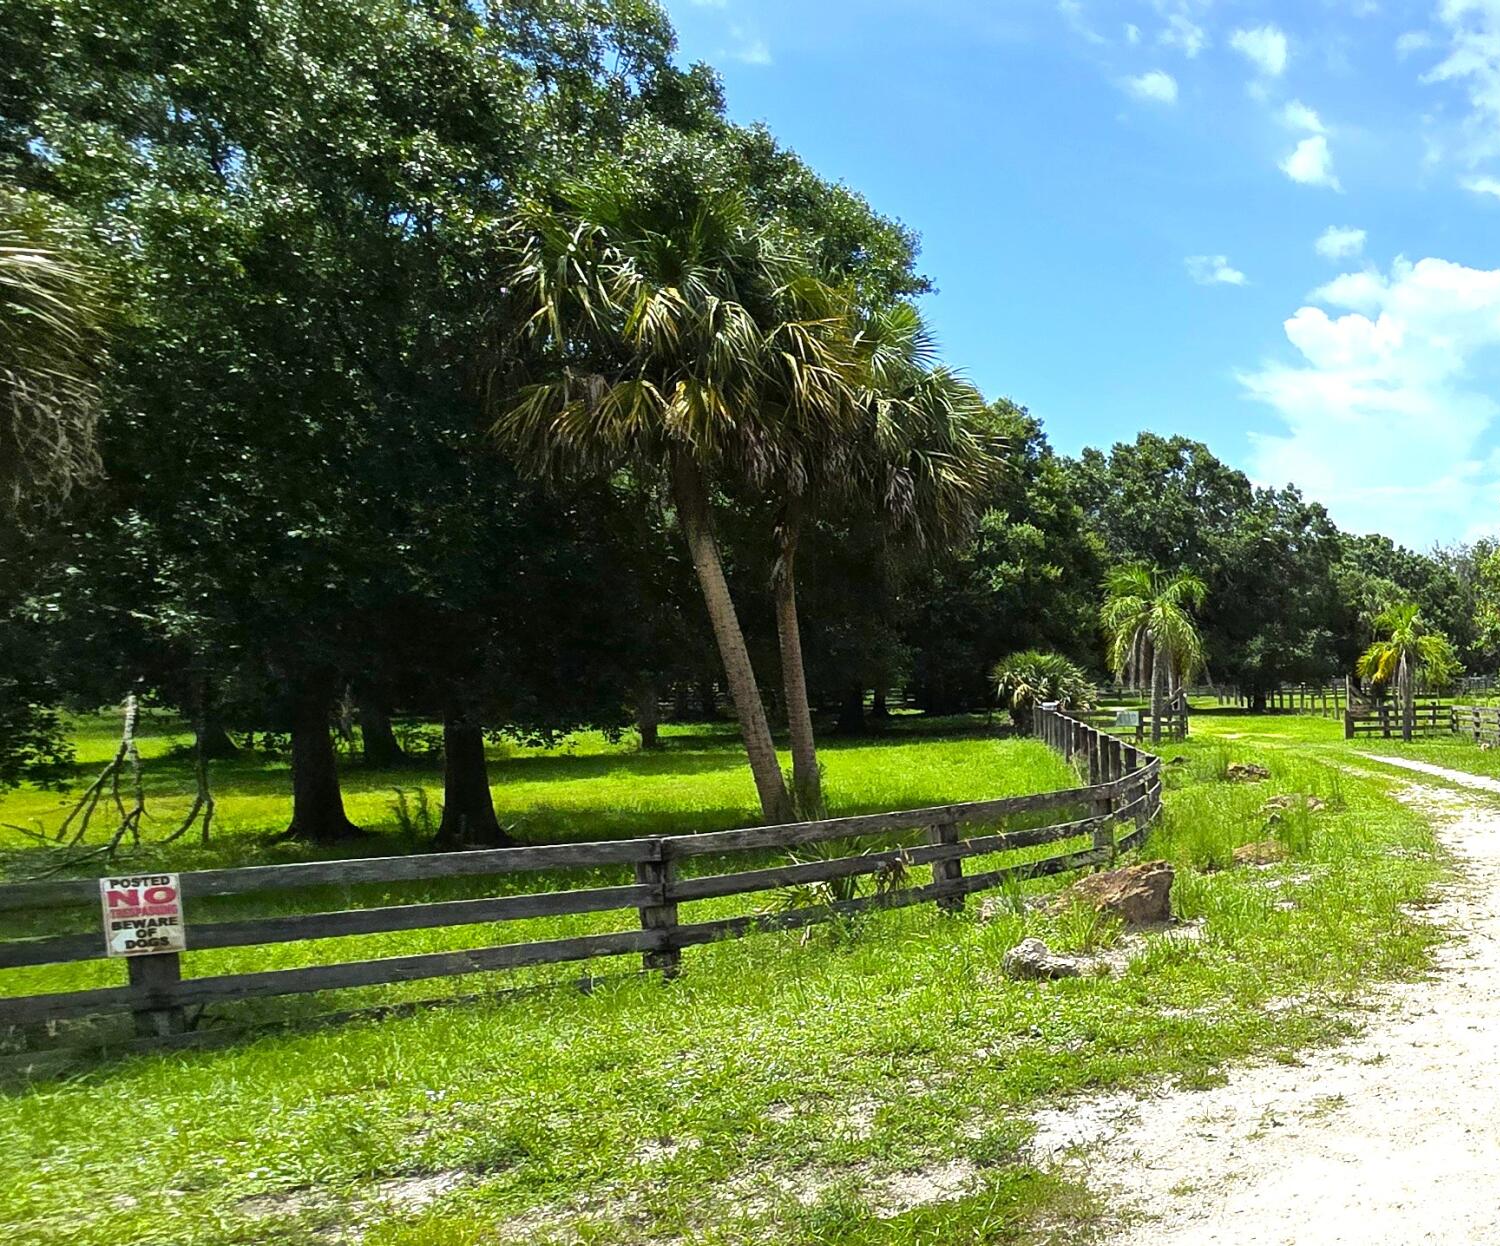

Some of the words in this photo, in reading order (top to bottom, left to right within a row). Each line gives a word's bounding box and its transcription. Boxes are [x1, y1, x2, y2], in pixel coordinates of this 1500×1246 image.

[110, 876, 170, 888] POSTED
[107, 888, 176, 907] NO
[112, 918, 178, 930] BEWARE
[136, 928, 157, 938] OF
[125, 937, 169, 949] DOGS
